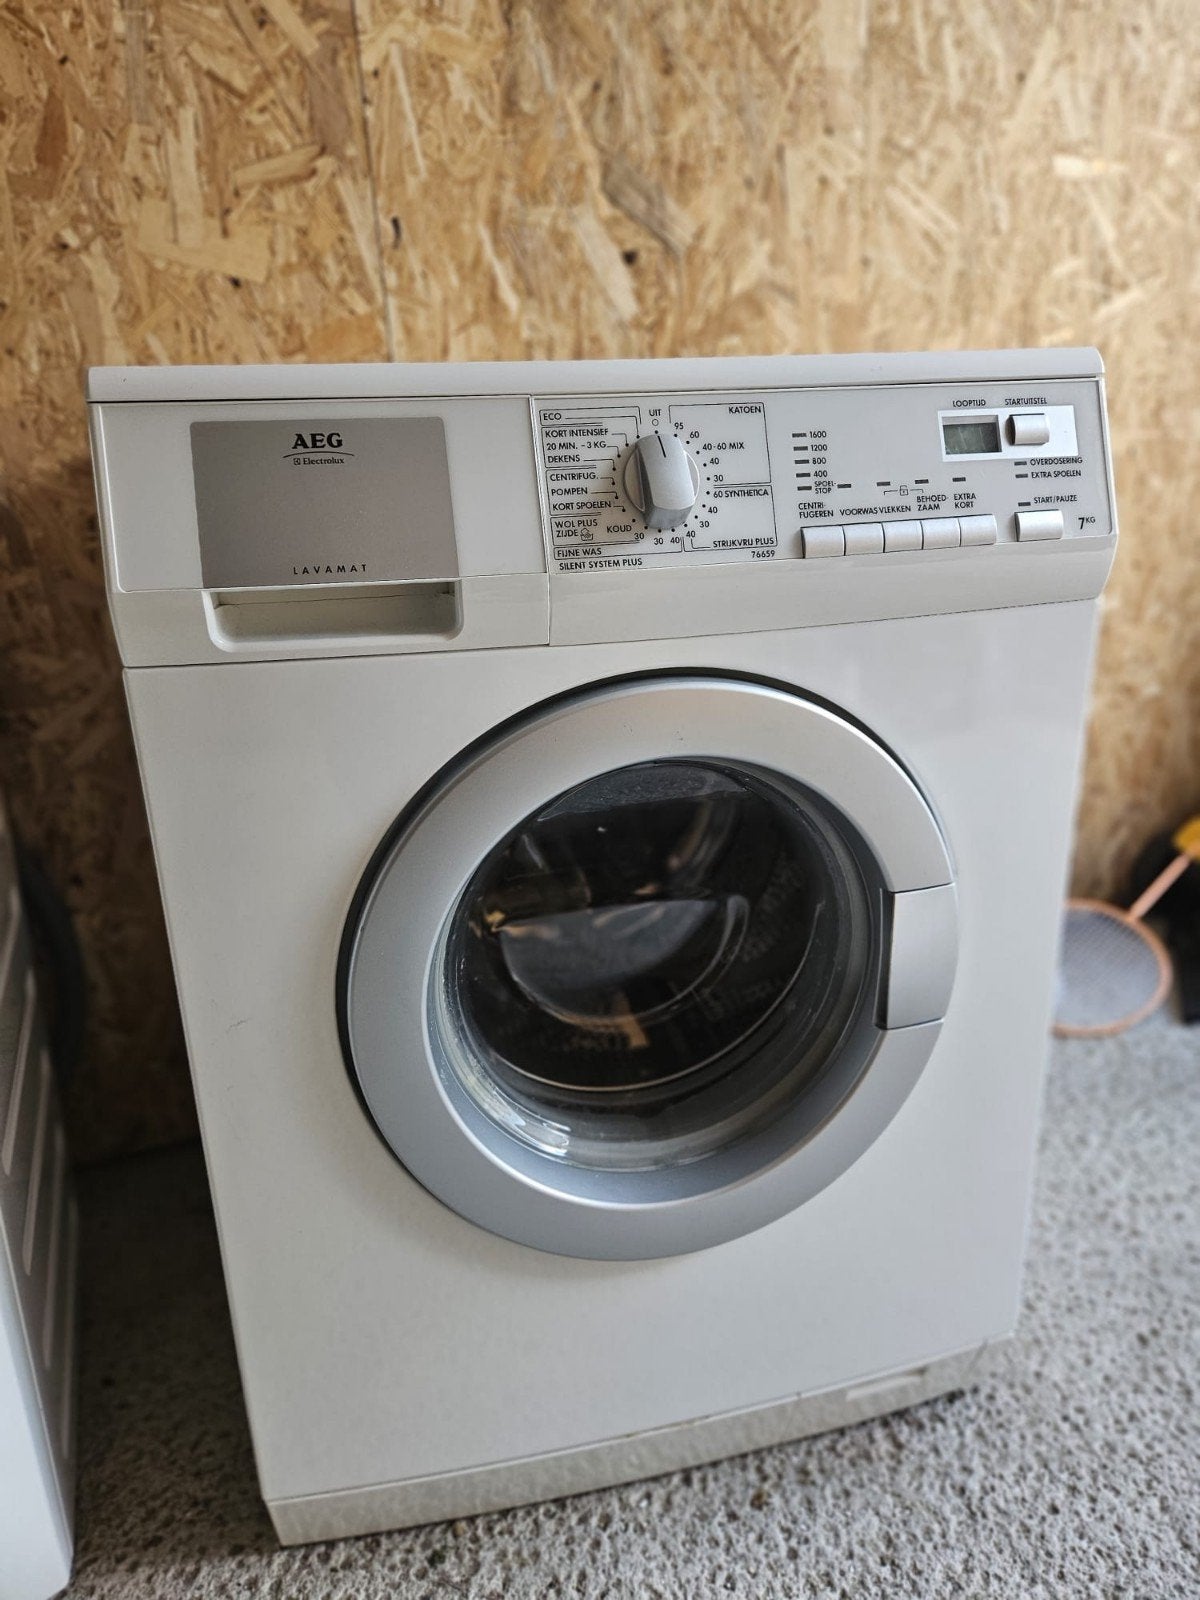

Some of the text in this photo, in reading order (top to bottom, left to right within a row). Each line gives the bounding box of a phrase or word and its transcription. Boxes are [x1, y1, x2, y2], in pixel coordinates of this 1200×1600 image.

[952, 399, 986, 408] LOOPTIJD
[1005, 397, 1047, 406] STARTUITSTEL
[650, 409, 661, 417] UIT
[729, 406, 761, 414] KATOEN
[543, 413, 562, 421] ECO
[674, 422, 684, 430] 95
[545, 428, 608, 438] KORT INTENSIEF
[690, 431, 699, 439] 60
[809, 431, 827, 439] 1600
[292, 433, 343, 449] AEG
[547, 442, 558, 450] 20
[560, 442, 578, 450] MIN.
[586, 441, 591, 449] 3
[593, 441, 607, 449] KG
[729, 442, 745, 450] MIX
[810, 444, 828, 452] 1200
[303, 457, 345, 465] Electrolux
[548, 455, 580, 463] DEKENS
[710, 457, 719, 465] 40
[812, 457, 826, 465] 800
[1030, 457, 1083, 466] OVERDOSERING
[550, 472, 598, 481] CENTRIFUG.
[714, 474, 723, 482] 30
[813, 470, 828, 478] 400
[1031, 470, 1081, 479] EXTRA SPOELEN
[551, 487, 587, 495] POMPEN
[713, 488, 769, 498] 60 SYNTHETICA
[954, 492, 976, 500] EXTRA
[1034, 494, 1077, 504] START/PAUZE
[553, 501, 611, 511] KORT SPOELEN
[917, 503, 940, 511] ZAAM
[955, 501, 974, 509] KORT
[708, 506, 718, 514] 40
[840, 505, 911, 516] VOORWAS VLEKKEN
[799, 510, 834, 519] FUGEREN
[555, 519, 597, 528] WOL PLUS
[700, 520, 710, 528] 30
[1078, 516, 1096, 529] 7 KG
[607, 524, 631, 533] KOUD
[556, 529, 579, 537] ZIJDE
[634, 532, 645, 540] 30
[686, 530, 696, 538] 40
[654, 537, 663, 545] 30
[670, 536, 680, 544] 40
[713, 537, 774, 548] STRIJKVRIJ PLUS
[557, 547, 602, 558] FIJNE WAS
[751, 550, 775, 558] 76659
[559, 558, 643, 571] SILENT SYSTEM PLUS
[293, 563, 367, 575] LAVAMAT
